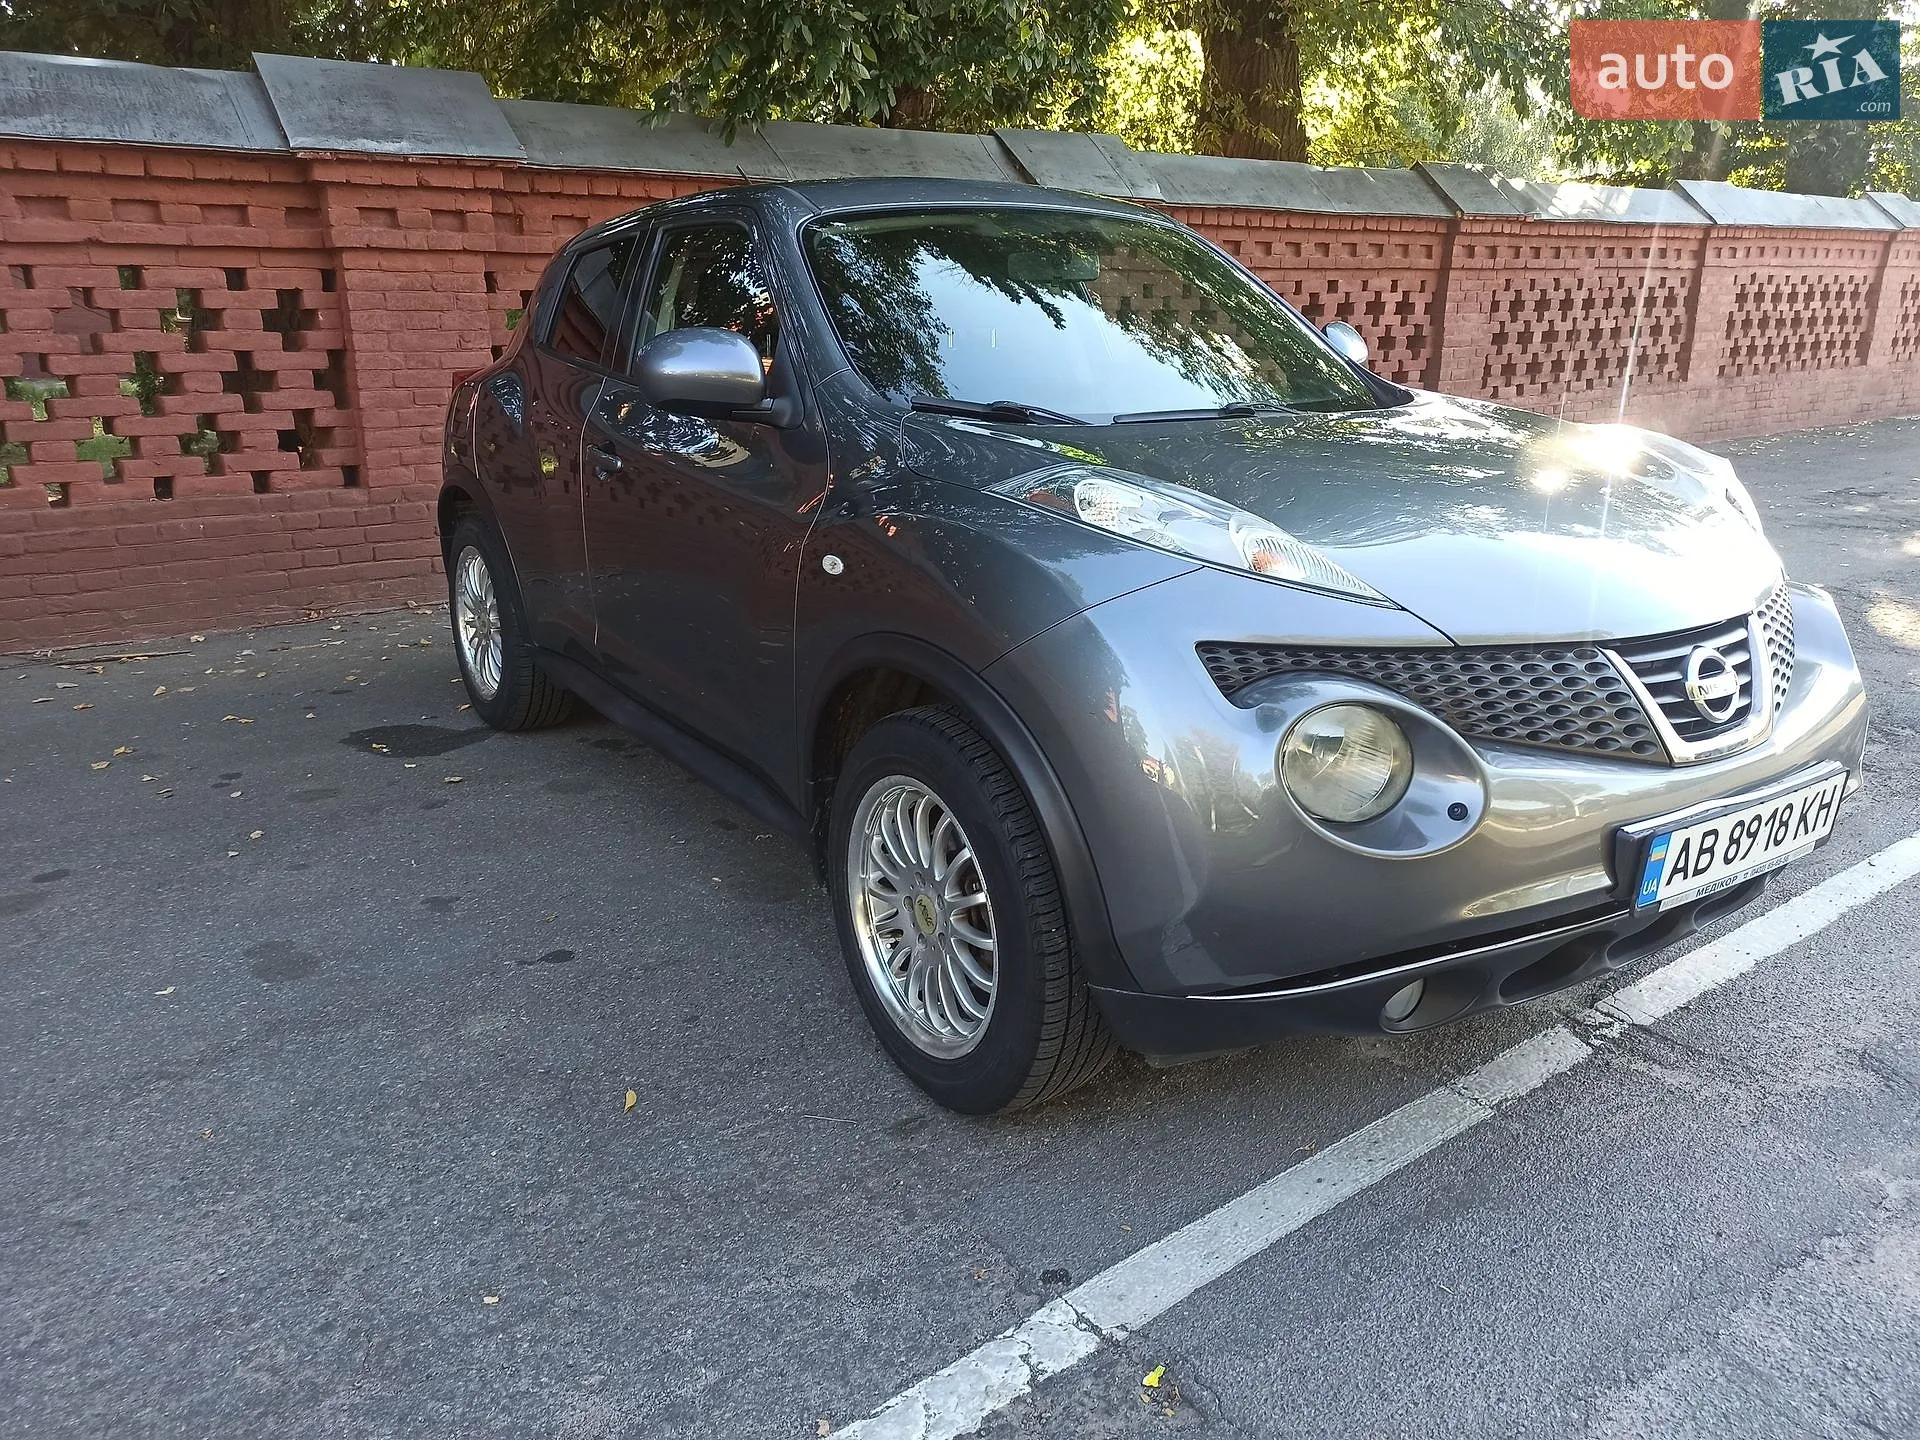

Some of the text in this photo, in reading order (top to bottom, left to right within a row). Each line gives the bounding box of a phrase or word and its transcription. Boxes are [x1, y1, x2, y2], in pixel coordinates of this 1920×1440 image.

[1665, 784, 1838, 887] AB 8918 KH
[1643, 878, 1657, 895] UA
[1695, 876, 1738, 898] МЕДІКОР
